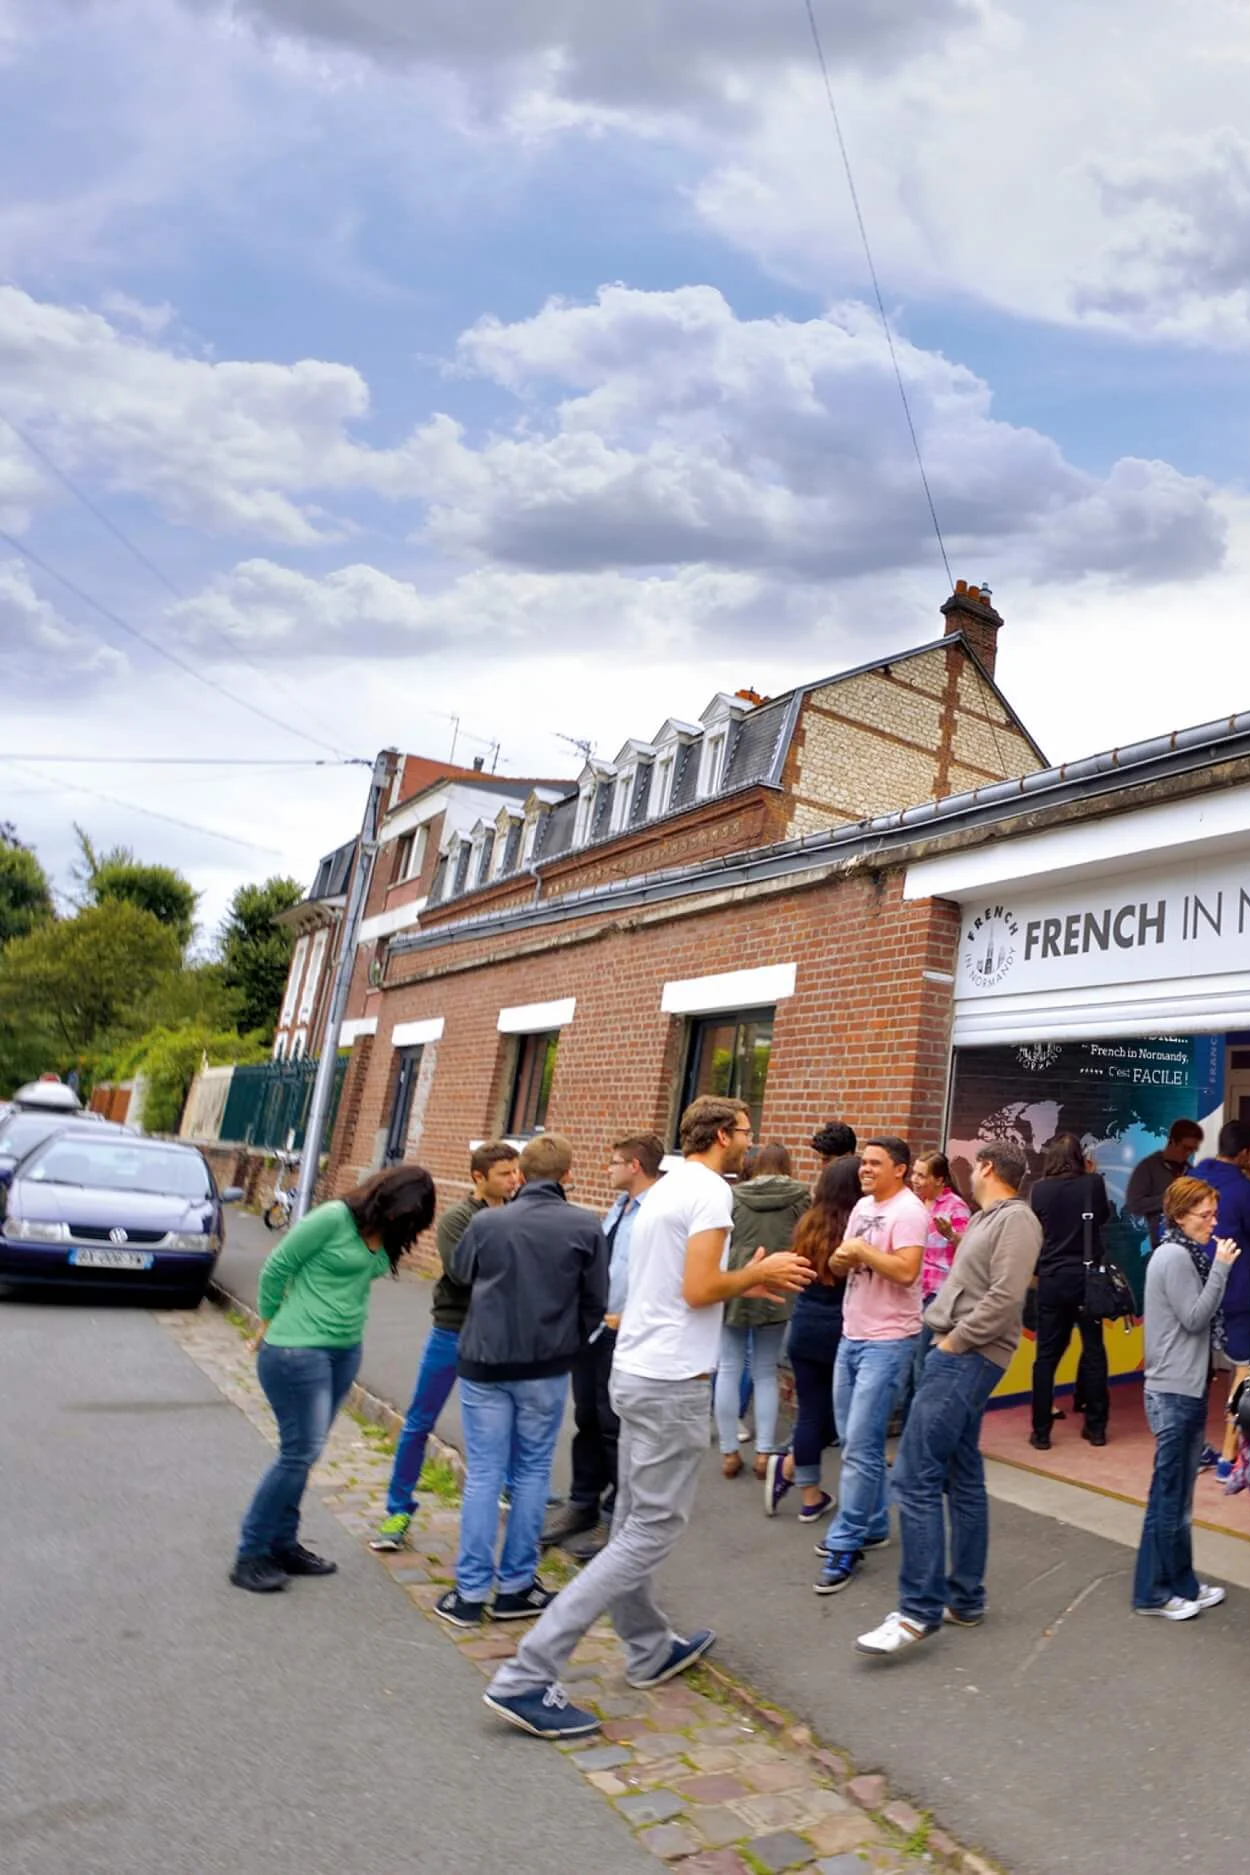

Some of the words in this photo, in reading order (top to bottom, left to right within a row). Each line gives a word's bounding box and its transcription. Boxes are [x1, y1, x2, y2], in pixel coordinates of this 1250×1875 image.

[967, 905, 1019, 942] FRENCH
[1024, 900, 1167, 961] FRENCH
[1182, 891, 1223, 940] IN
[968, 946, 1017, 988] NORMANDY
[1090, 1043, 1126, 1058] French
[1127, 1048, 1138, 1058] in
[1209, 1034, 1218, 1084] FRANC
[1133, 1068, 1183, 1086] FACILE
